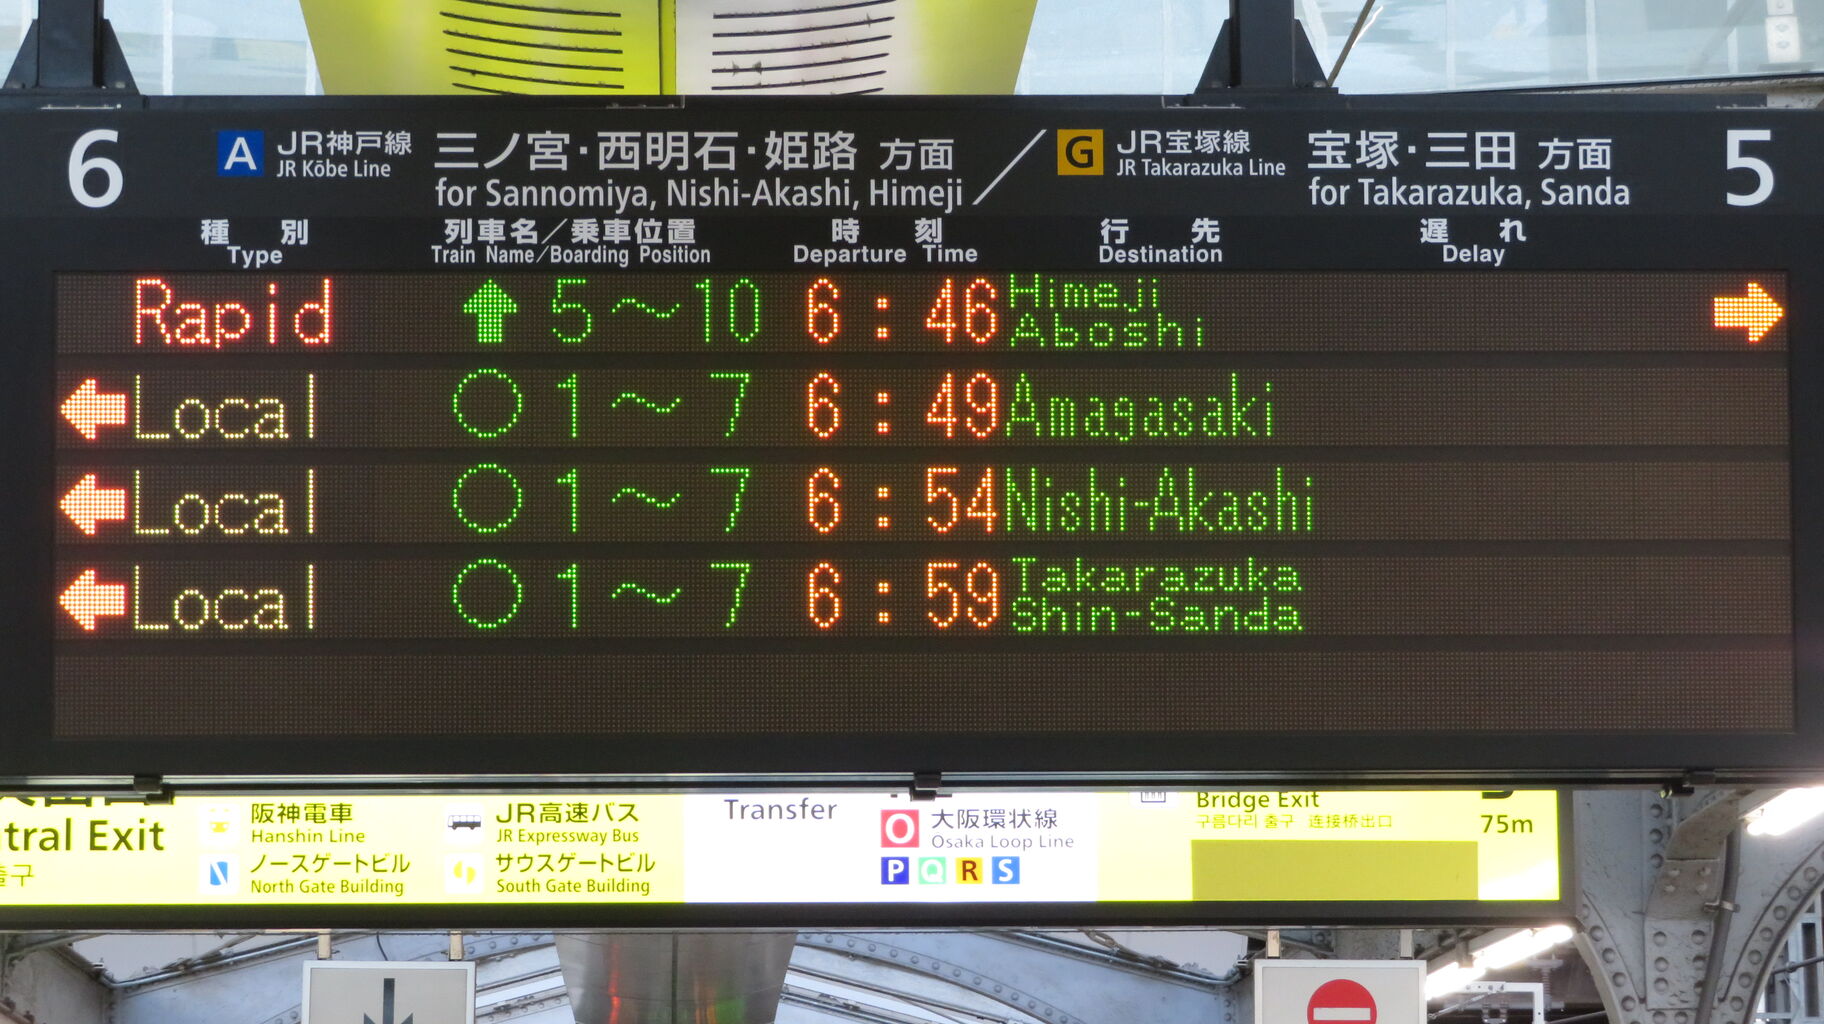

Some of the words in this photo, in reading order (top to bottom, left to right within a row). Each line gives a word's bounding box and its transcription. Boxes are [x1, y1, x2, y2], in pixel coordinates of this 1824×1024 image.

[225, 137, 256, 169] A
[278, 131, 411, 155] JR神戸線
[1066, 136, 1093, 168] G
[1117, 130, 1250, 153] JR宝塚線
[880, 139, 953, 170] 方面
[1539, 138, 1611, 169] 方面
[69, 129, 123, 207] 6
[277, 160, 296, 177] JR
[355, 160, 390, 177] Line
[1117, 159, 1136, 175] JR
[1142, 158, 1242, 175] Takarazuka
[1250, 159, 1285, 175] Line
[1727, 130, 1774, 206] 5
[436, 177, 476, 206] for
[487, 179, 655, 214] Sannomiya,
[668, 178, 858, 210] Nishi-Akashi,
[871, 179, 961, 213] Himeji
[1309, 176, 1350, 205] for
[1358, 177, 1530, 209] Takarazuka,
[1542, 177, 1629, 205] Sanda
[227, 246, 284, 268] Type
[431, 246, 475, 263] Train
[640, 246, 711, 263] Position
[793, 245, 907, 266] Departure
[922, 245, 978, 262] Time
[1099, 245, 1223, 263] Destination
[1443, 245, 1504, 266] Delay
[1010, 273, 1161, 312] Himeji
[135, 277, 333, 349] Rapid
[1010, 313, 1203, 347] Aboshi
[136, 374, 314, 439] Local
[1007, 373, 1271, 441] Amagasaki
[135, 469, 314, 534] Local
[1007, 468, 1311, 531] Nishi-Akashi
[1013, 557, 1302, 591] Takarazuka
[135, 565, 313, 630] Local
[1012, 597, 1304, 632] Shin-Sanda
[252, 803, 352, 824] 阪神電車
[496, 803, 638, 823] JR高速バス
[724, 799, 838, 820] Transfer
[1198, 793, 1269, 812] Bridge
[1279, 793, 1319, 807] Exit
[932, 809, 1057, 829] 大阪環状線
[1197, 814, 1257, 829] 구름다리
[1265, 814, 1294, 829] 출구
[1481, 815, 1532, 833] 75m
[90, 818, 164, 851] Exit
[252, 829, 322, 842] Hanshin
[330, 830, 364, 842] Line
[497, 829, 512, 842] JR
[519, 829, 607, 846] Expressway
[613, 829, 638, 842] Bus
[932, 835, 983, 848] Osaka
[991, 836, 1032, 851] Loop
[1040, 836, 1073, 847] Line
[251, 854, 410, 873] ノースゲートビル
[496, 853, 655, 872] サウスゲートビル
[886, 859, 905, 882] P
[961, 860, 978, 881] R
[998, 858, 1013, 882] S
[252, 880, 293, 893] North
[300, 880, 334, 893] Gate
[341, 879, 403, 896] Building
[497, 879, 540, 892] South
[546, 879, 581, 892] Gate
[588, 878, 649, 896] Building
